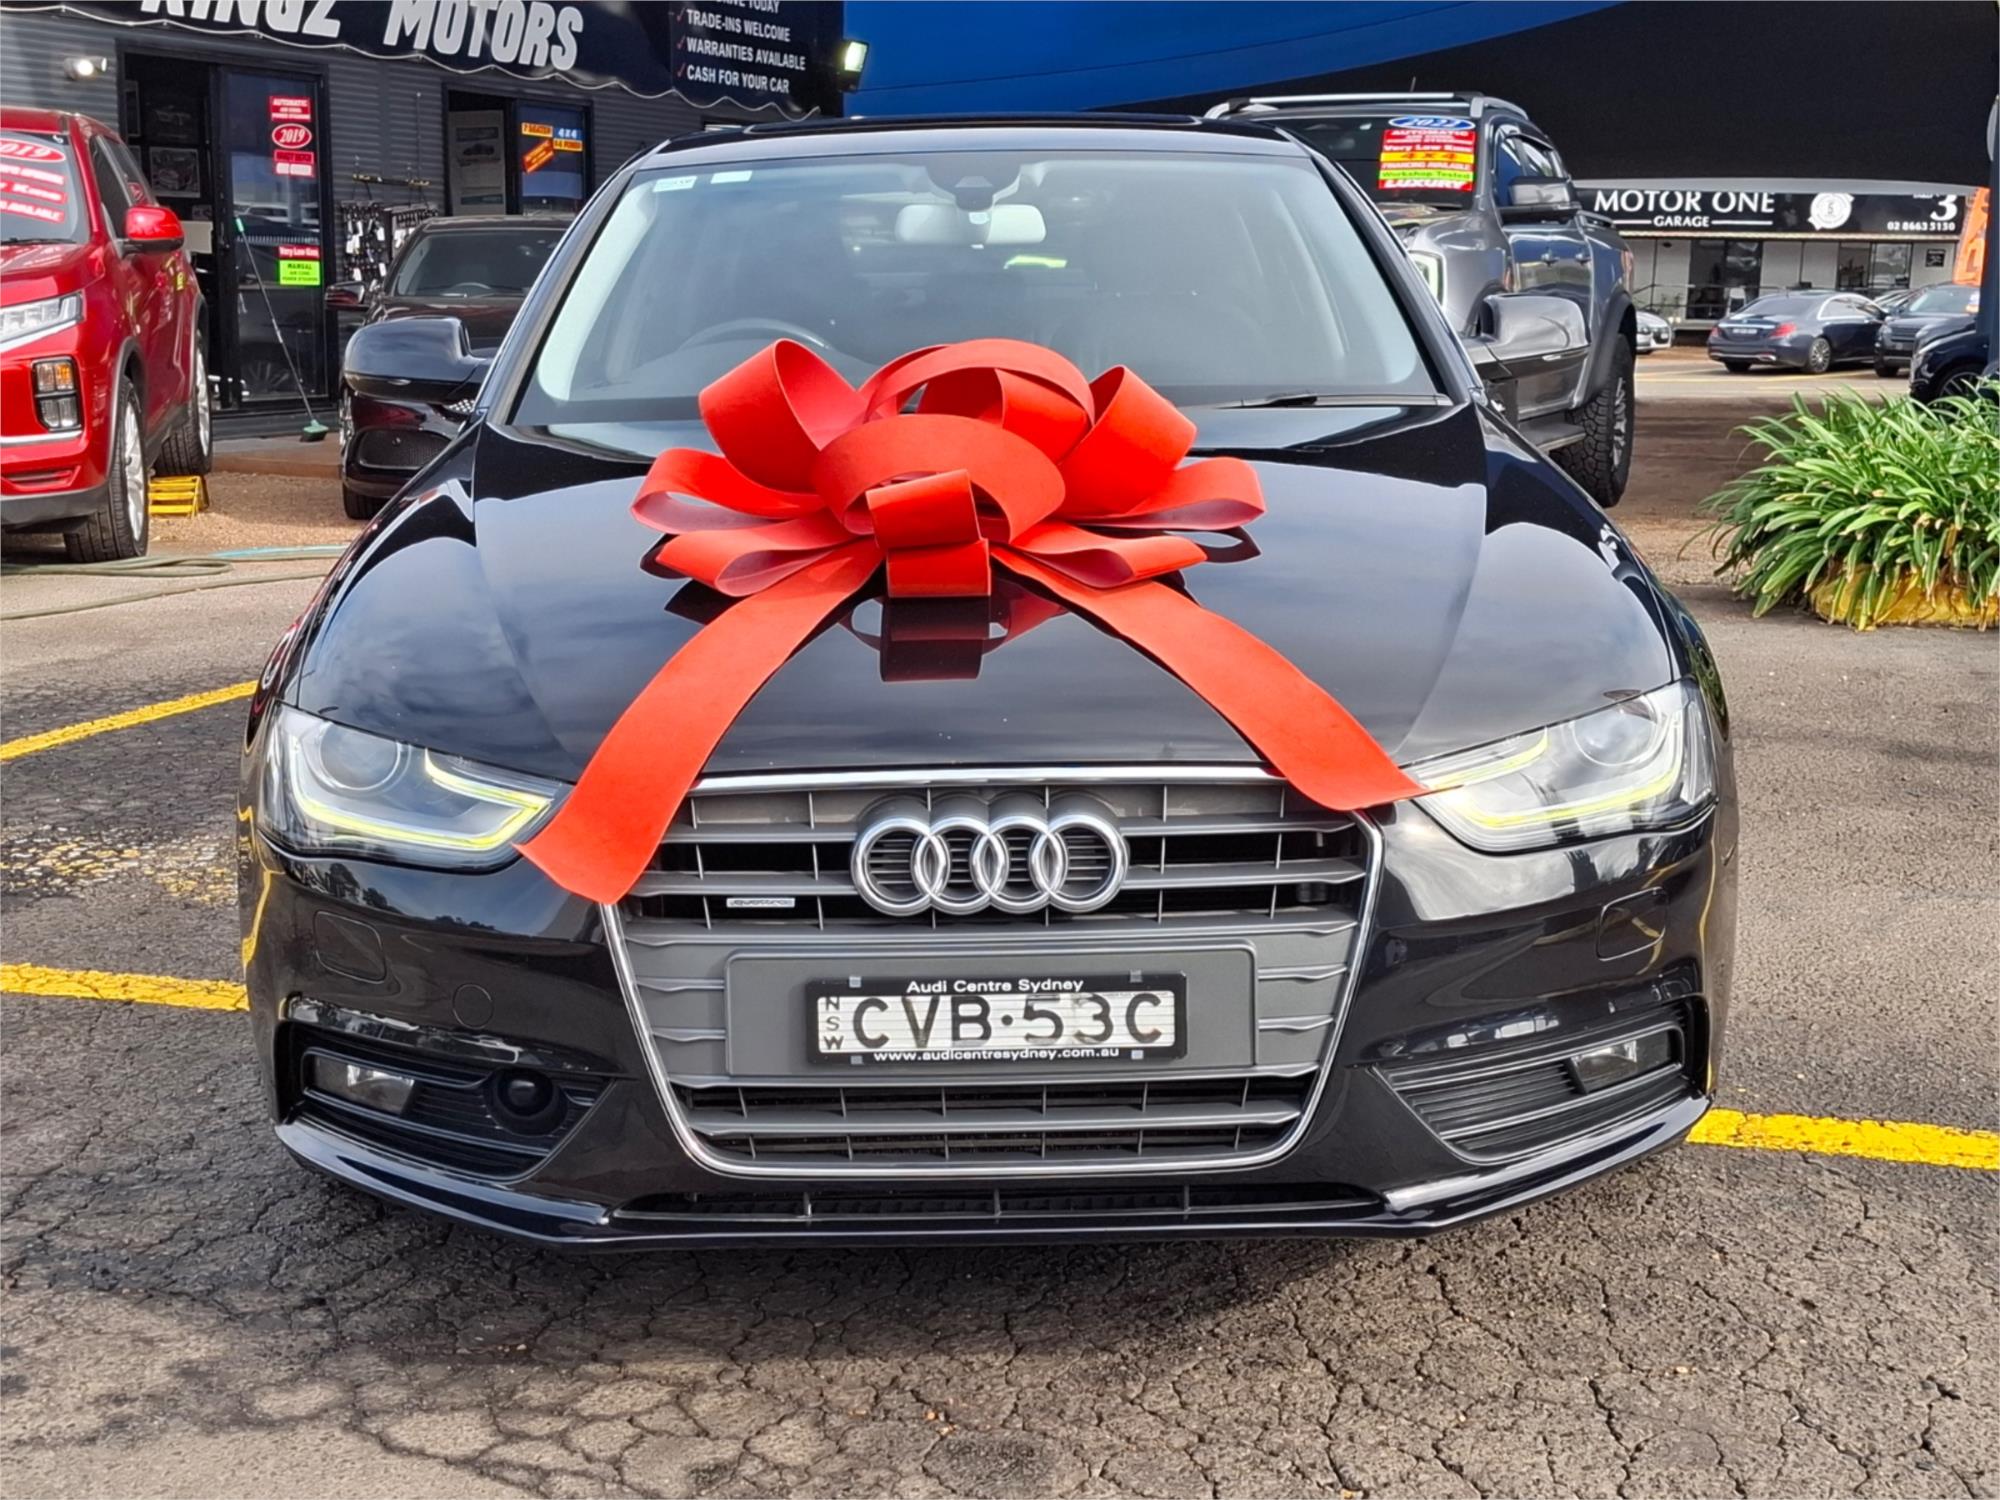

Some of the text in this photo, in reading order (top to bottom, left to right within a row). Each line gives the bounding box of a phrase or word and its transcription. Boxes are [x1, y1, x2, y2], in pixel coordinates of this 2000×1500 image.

[686, 9, 791, 42] TRADE-INS WELCOME
[383, 1, 584, 71] MOTORS
[686, 37, 806, 71] WARRANTIES AVAILABLE
[686, 64, 790, 94] CASH FOR YOUR CAR
[280, 128, 306, 143] 2019
[0, 141, 53, 158] 019
[1436, 171, 1471, 179] Tested
[1383, 179, 1467, 189] LUXURY
[1594, 189, 1775, 213] MOTOR ONE
[1930, 194, 1958, 221] 3
[1652, 215, 1710, 228] GARAGE
[1887, 221, 1900, 231] 02
[906, 978, 1084, 994] Audi Centre Sydney
[873, 1047, 1120, 1061] www.audicentresydney.com.au
